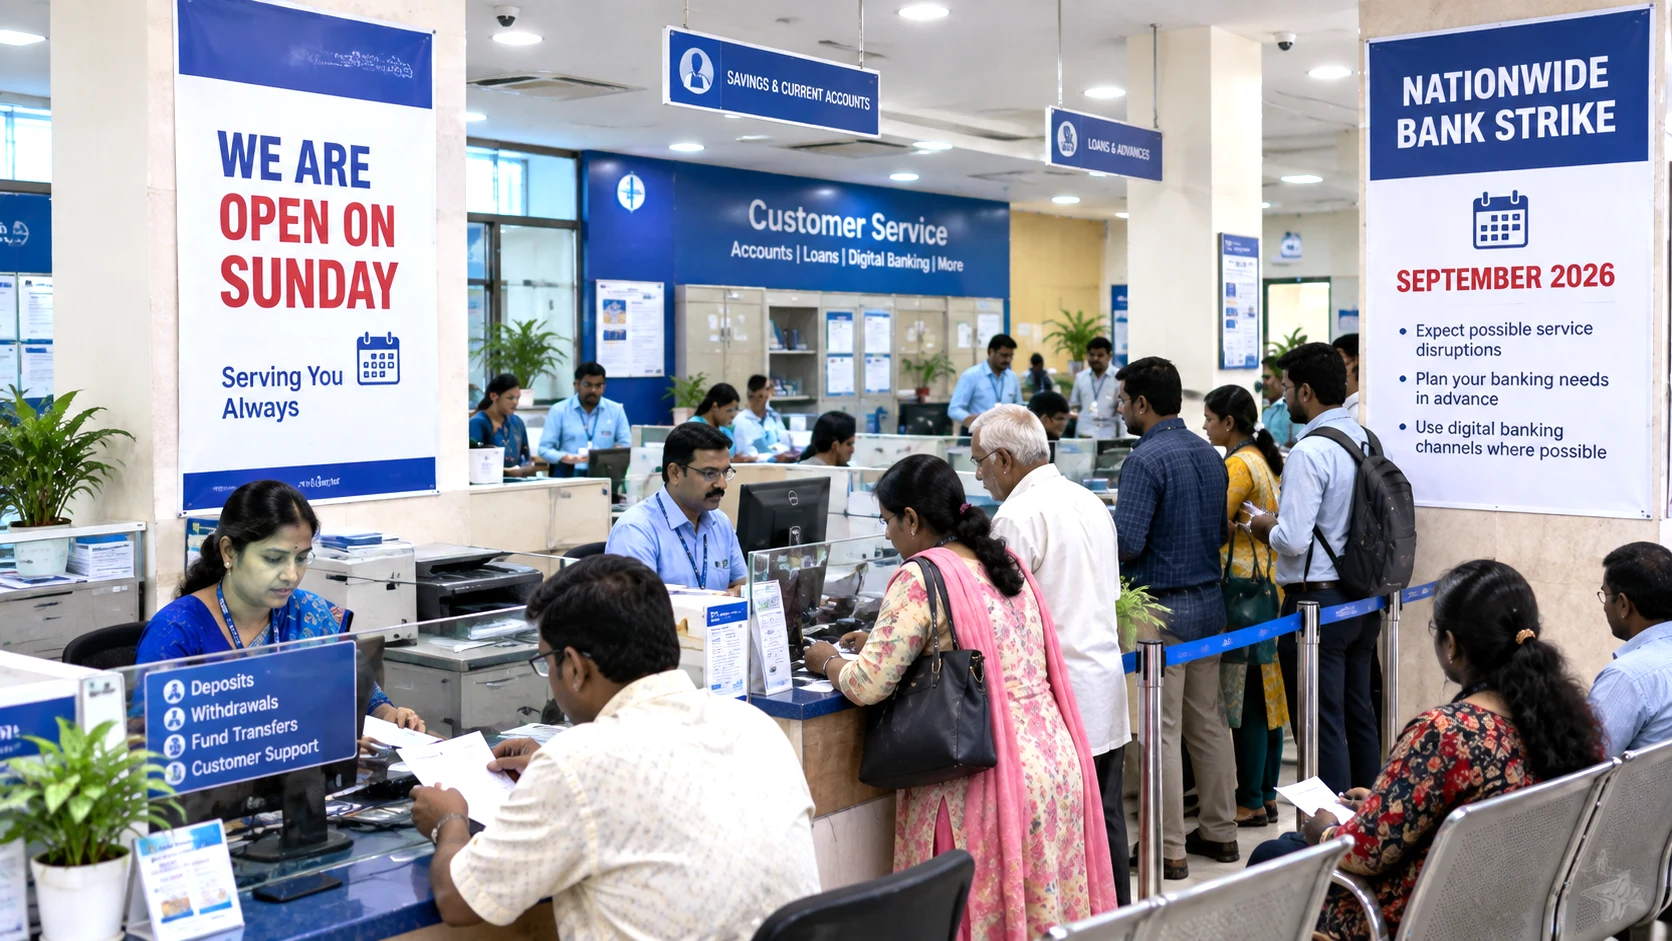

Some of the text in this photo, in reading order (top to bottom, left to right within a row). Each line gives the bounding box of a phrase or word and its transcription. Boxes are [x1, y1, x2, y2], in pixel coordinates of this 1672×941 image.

[727, 70, 870, 110] SAVINGS & CURRENT ACCOUNTS
[1403, 55, 1609, 107] NATIONWIDE
[1397, 99, 1616, 149] BANK STRIKE
[217, 130, 370, 189] WE ARE
[1088, 138, 1150, 161] LOANS & ADVANCES
[220, 193, 394, 247] OPEN ON
[749, 198, 947, 245] Customer Service
[731, 241, 793, 260] Accounts
[804, 246, 839, 264] Loans
[849, 249, 884, 269] Digital
[887, 252, 930, 273] Banking
[938, 257, 963, 271] More
[221, 255, 398, 309] SUNDAY
[1397, 262, 1615, 293] SEPTEMBER 2026
[1417, 321, 1593, 340] Expect possible service
[1417, 343, 1501, 359] disruptions
[222, 366, 342, 391] Serving You
[1417, 372, 1609, 389] Plan your banking needs
[222, 397, 299, 422] Always
[1417, 391, 1498, 406] in advance
[1415, 420, 1564, 441] Use digital banking
[1415, 439, 1606, 460] channels where possible
[191, 673, 255, 697] Deposits
[191, 694, 279, 723] Withdrawals
[192, 719, 298, 750] Fund Transfers
[192, 738, 320, 777] Customer Support
